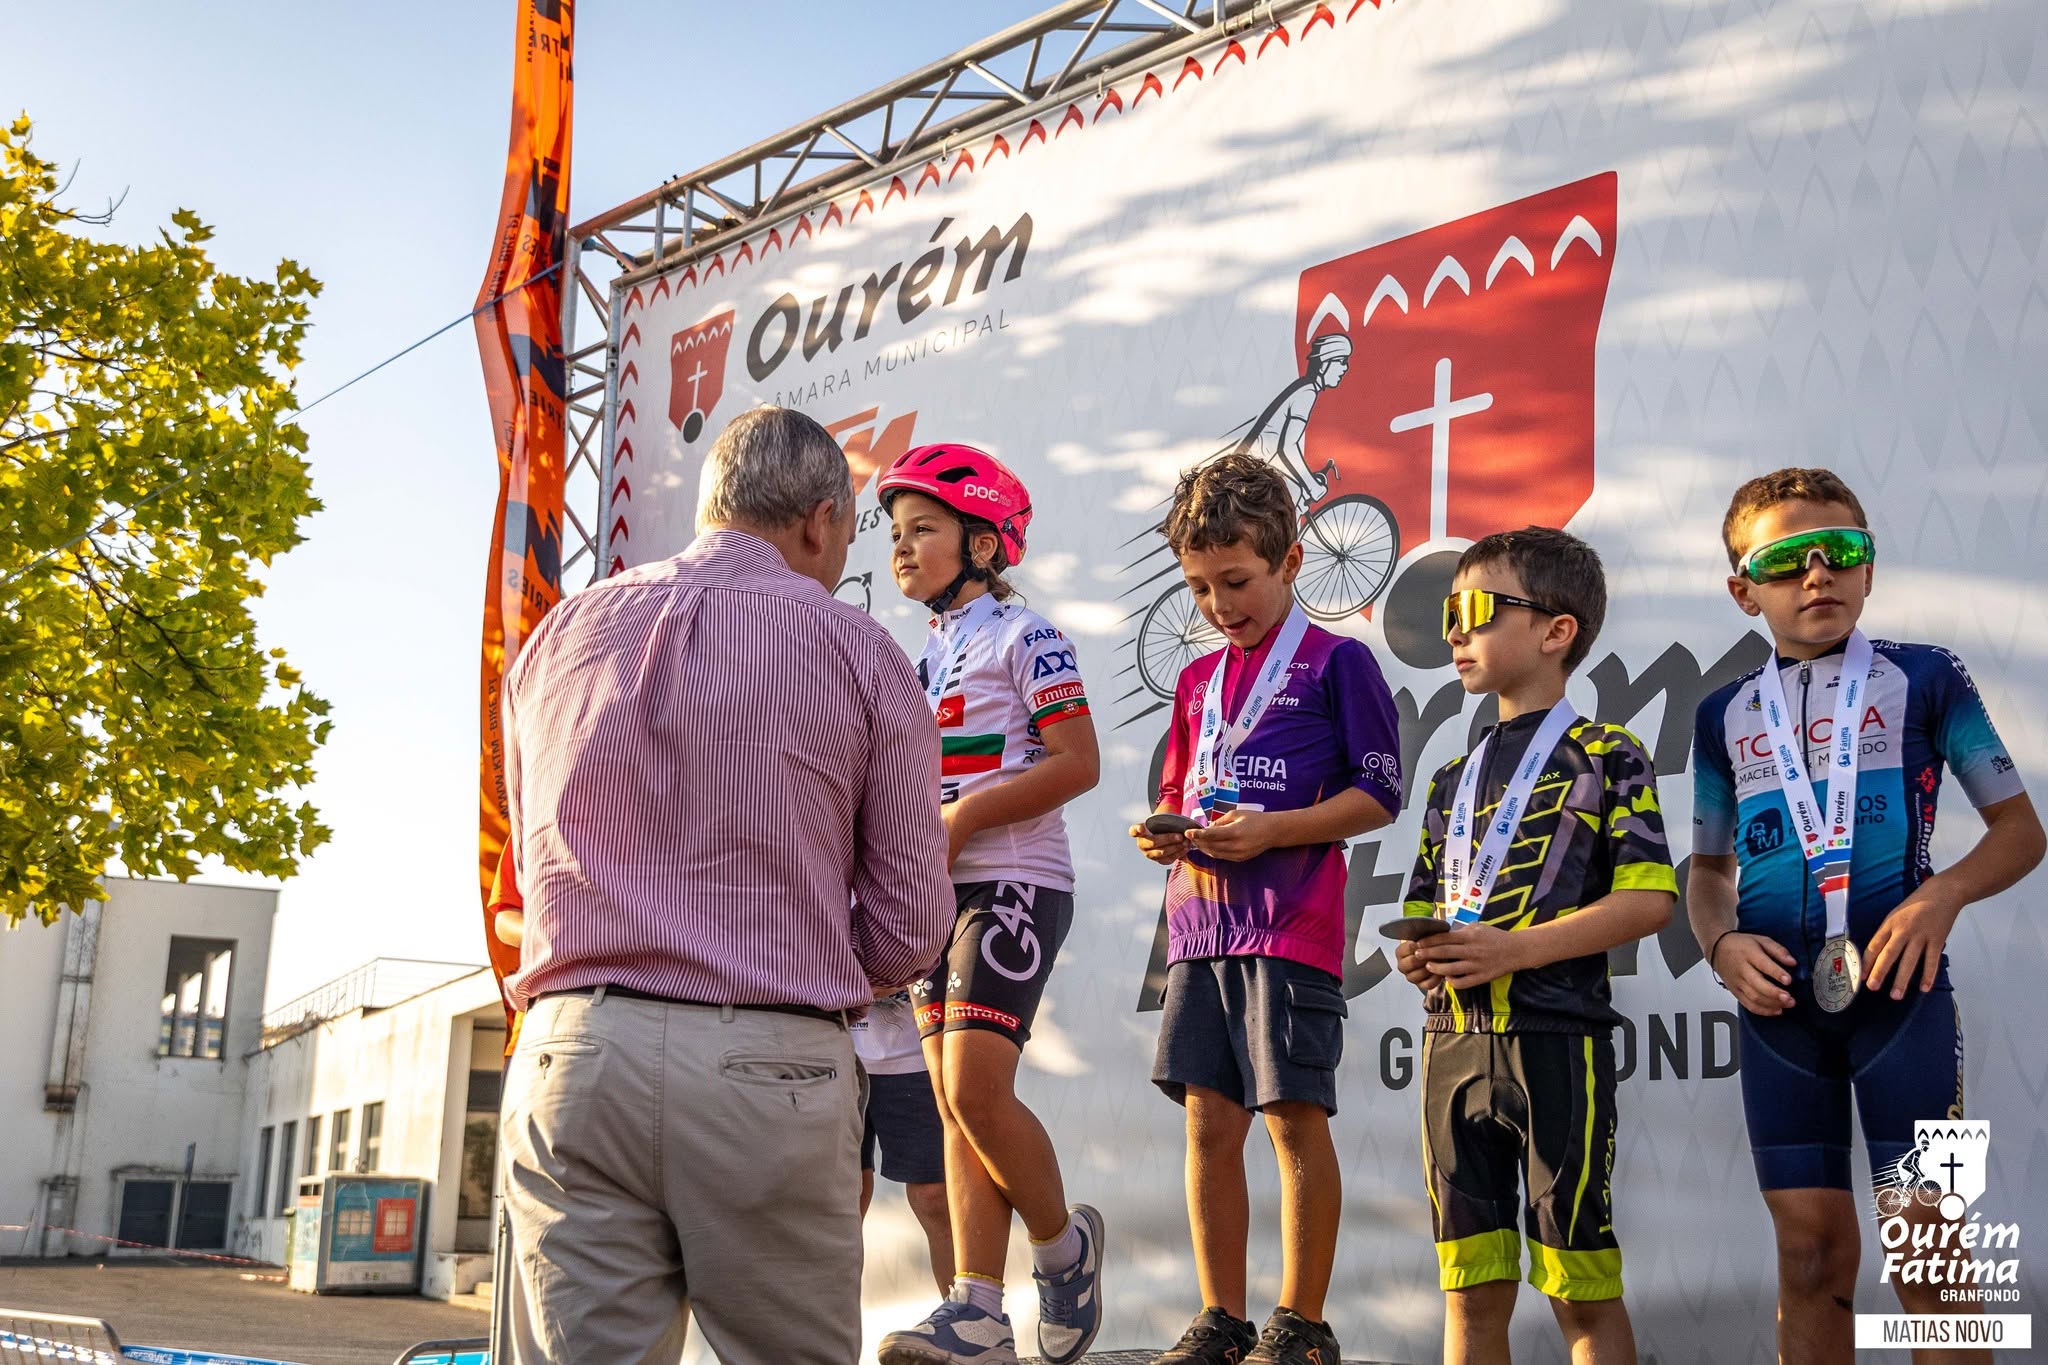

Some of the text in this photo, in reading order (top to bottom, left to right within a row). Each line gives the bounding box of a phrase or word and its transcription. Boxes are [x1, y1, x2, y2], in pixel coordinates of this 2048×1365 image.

[746, 212, 1033, 383] Ourém
[864, 308, 1010, 381] MUNICIPAL
[1024, 628, 1057, 648] FAB
[1735, 705, 1886, 763] TOOA
[1240, 778, 1287, 792] acionais
[1796, 801, 1812, 833] Ourém
[1835, 790, 1846, 824] Ourém
[1828, 838, 1851, 848] KIDS
[1476, 854, 1494, 888] Ourém
